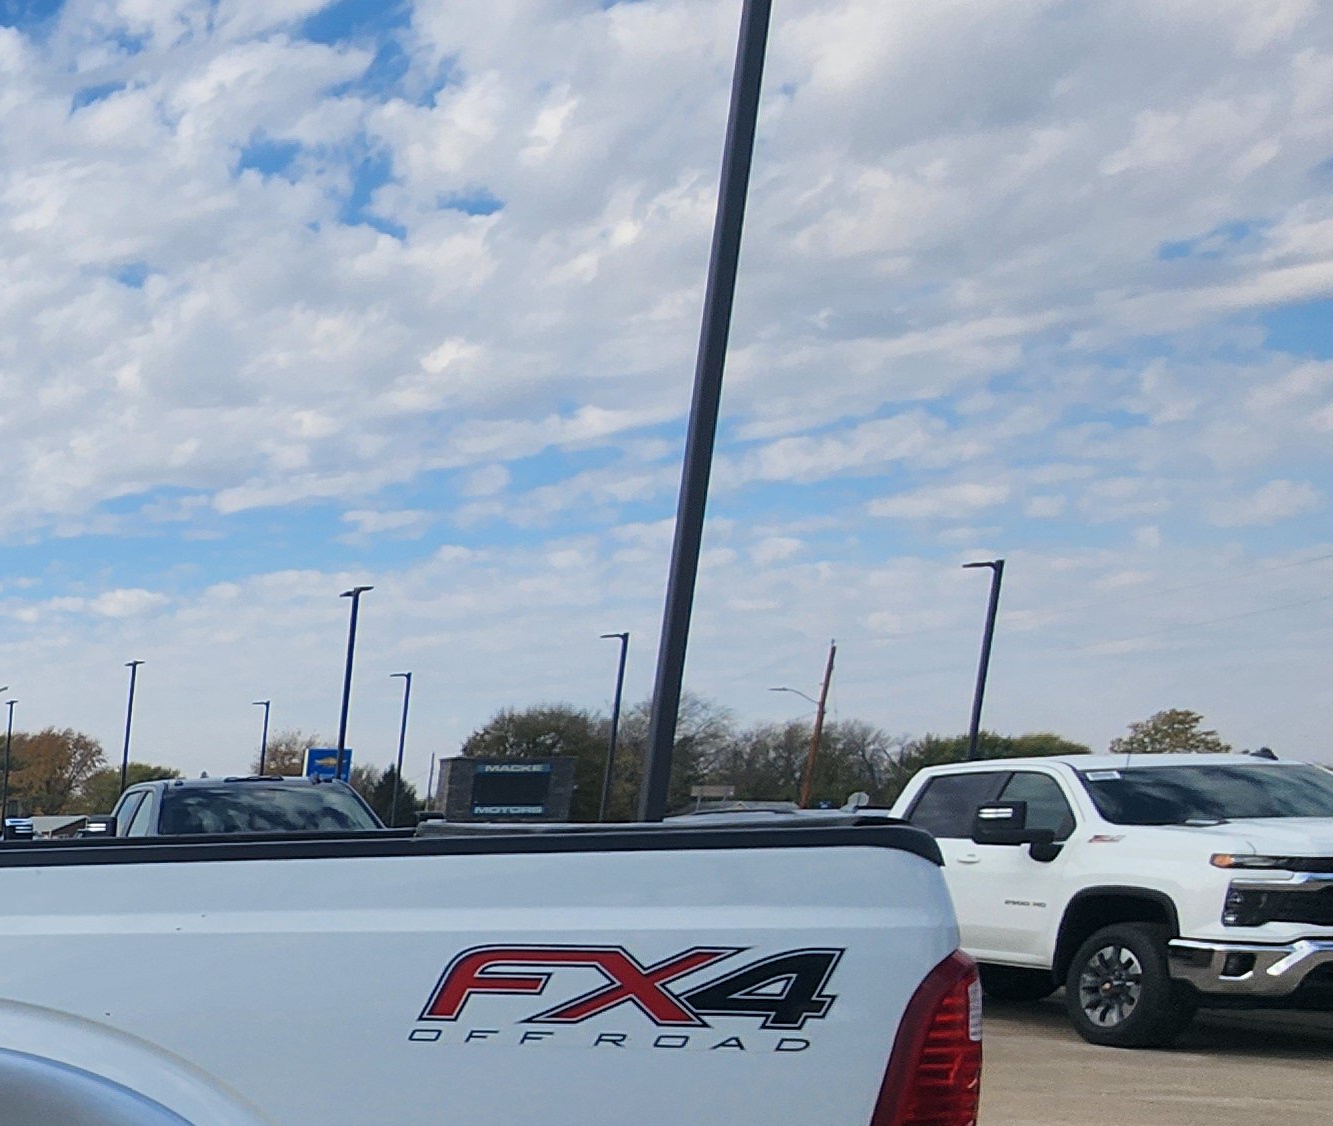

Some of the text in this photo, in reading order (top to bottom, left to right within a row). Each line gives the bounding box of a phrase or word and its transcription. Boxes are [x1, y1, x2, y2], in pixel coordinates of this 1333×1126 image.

[484, 764, 542, 772] MACKE
[474, 806, 543, 814] MOTORS
[418, 944, 846, 1030] FX4
[408, 1029, 810, 1052] OFF ROAD
